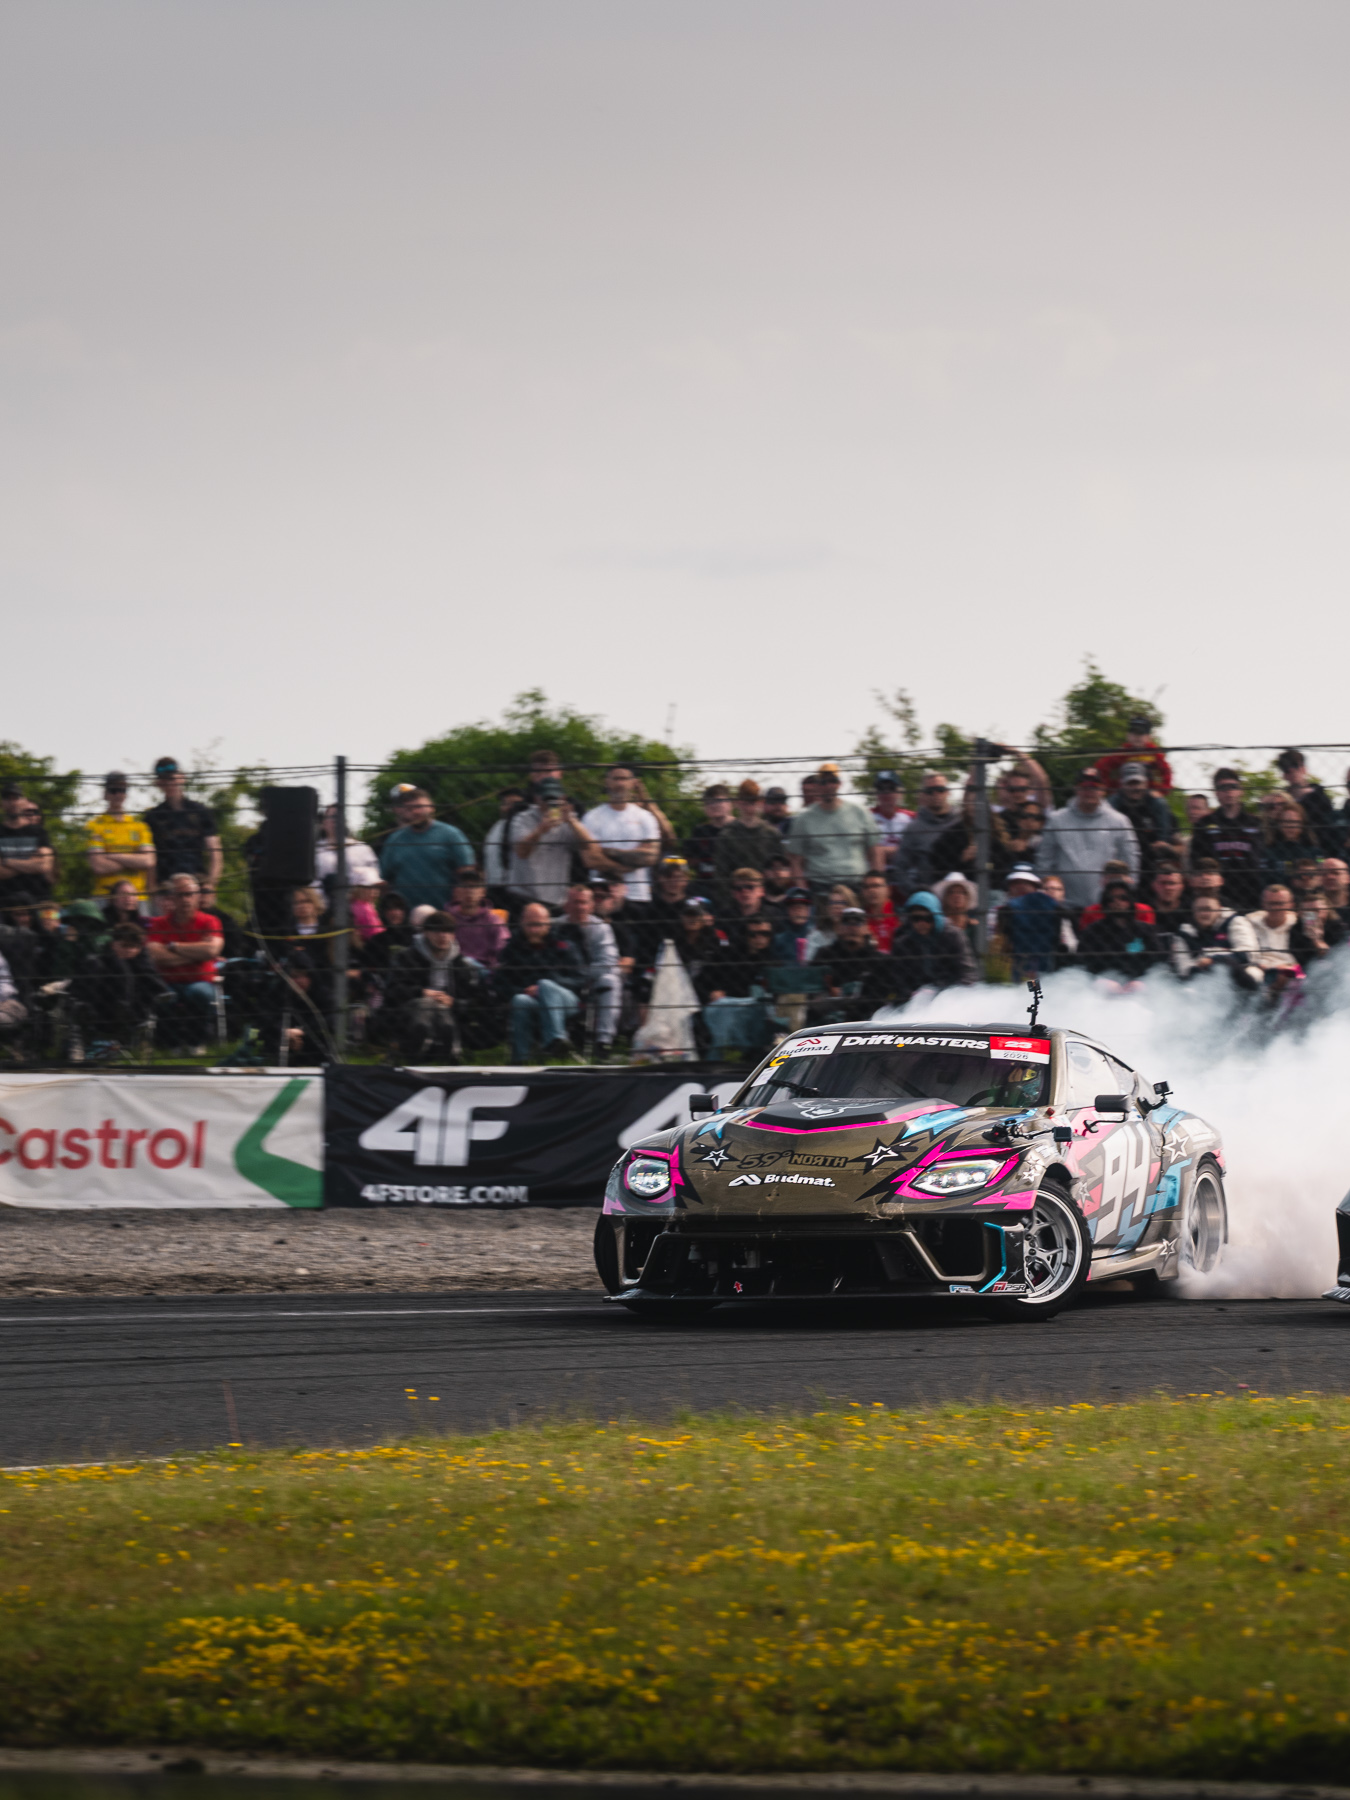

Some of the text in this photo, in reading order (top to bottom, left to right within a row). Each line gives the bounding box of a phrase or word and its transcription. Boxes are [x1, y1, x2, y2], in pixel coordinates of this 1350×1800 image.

[1004, 1040, 1033, 1049] 23
[1003, 1051, 1029, 1060] 2026
[358, 1086, 529, 1167] 4F
[360, 1184, 529, 1203] 4FSTORE.COM
